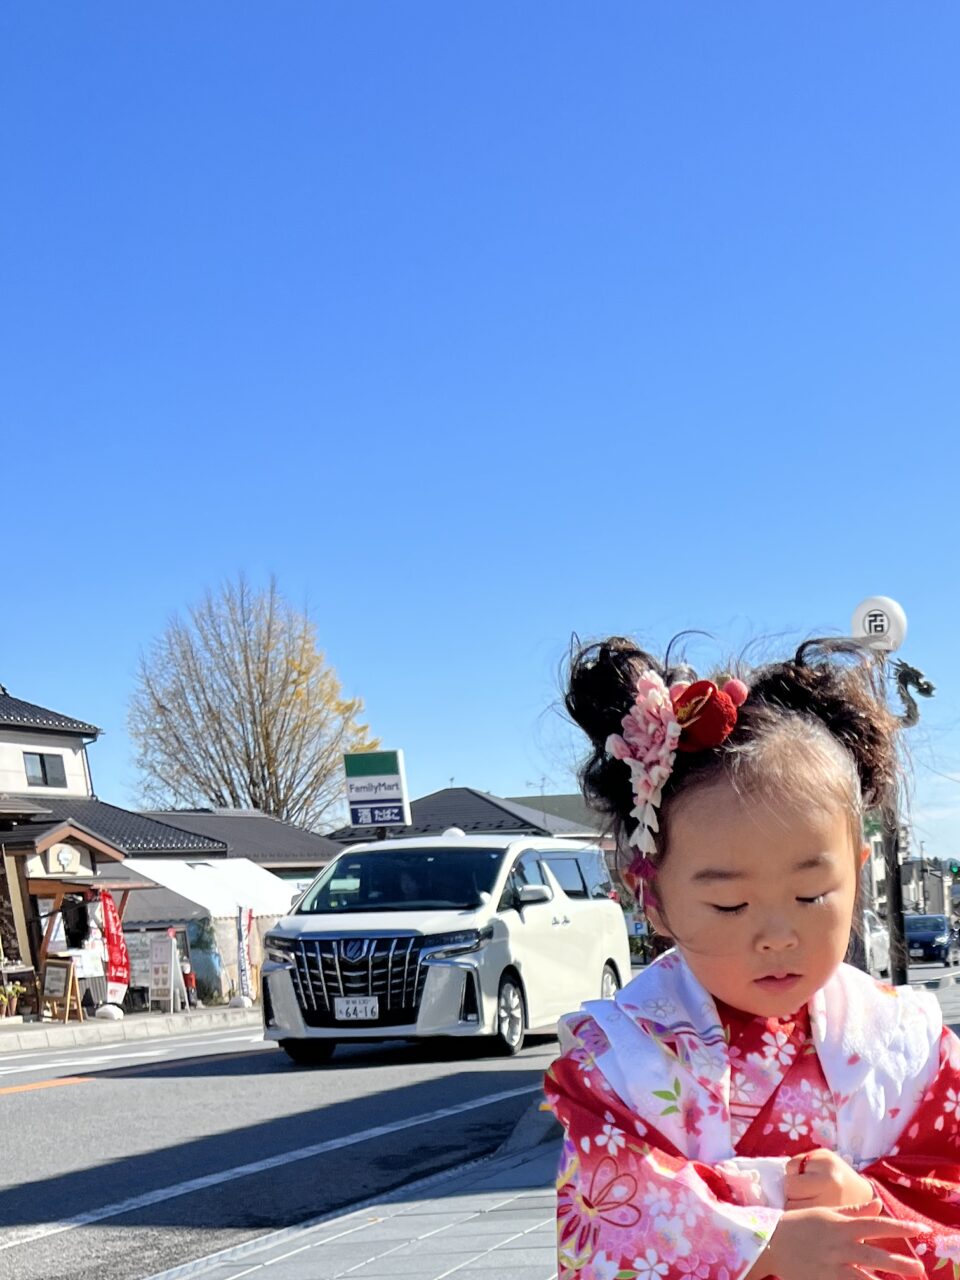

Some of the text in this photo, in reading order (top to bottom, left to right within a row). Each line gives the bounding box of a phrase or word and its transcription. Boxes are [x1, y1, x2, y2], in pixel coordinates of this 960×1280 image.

[349, 783, 399, 794] FamilyMart
[374, 808, 400, 821] たばこ
